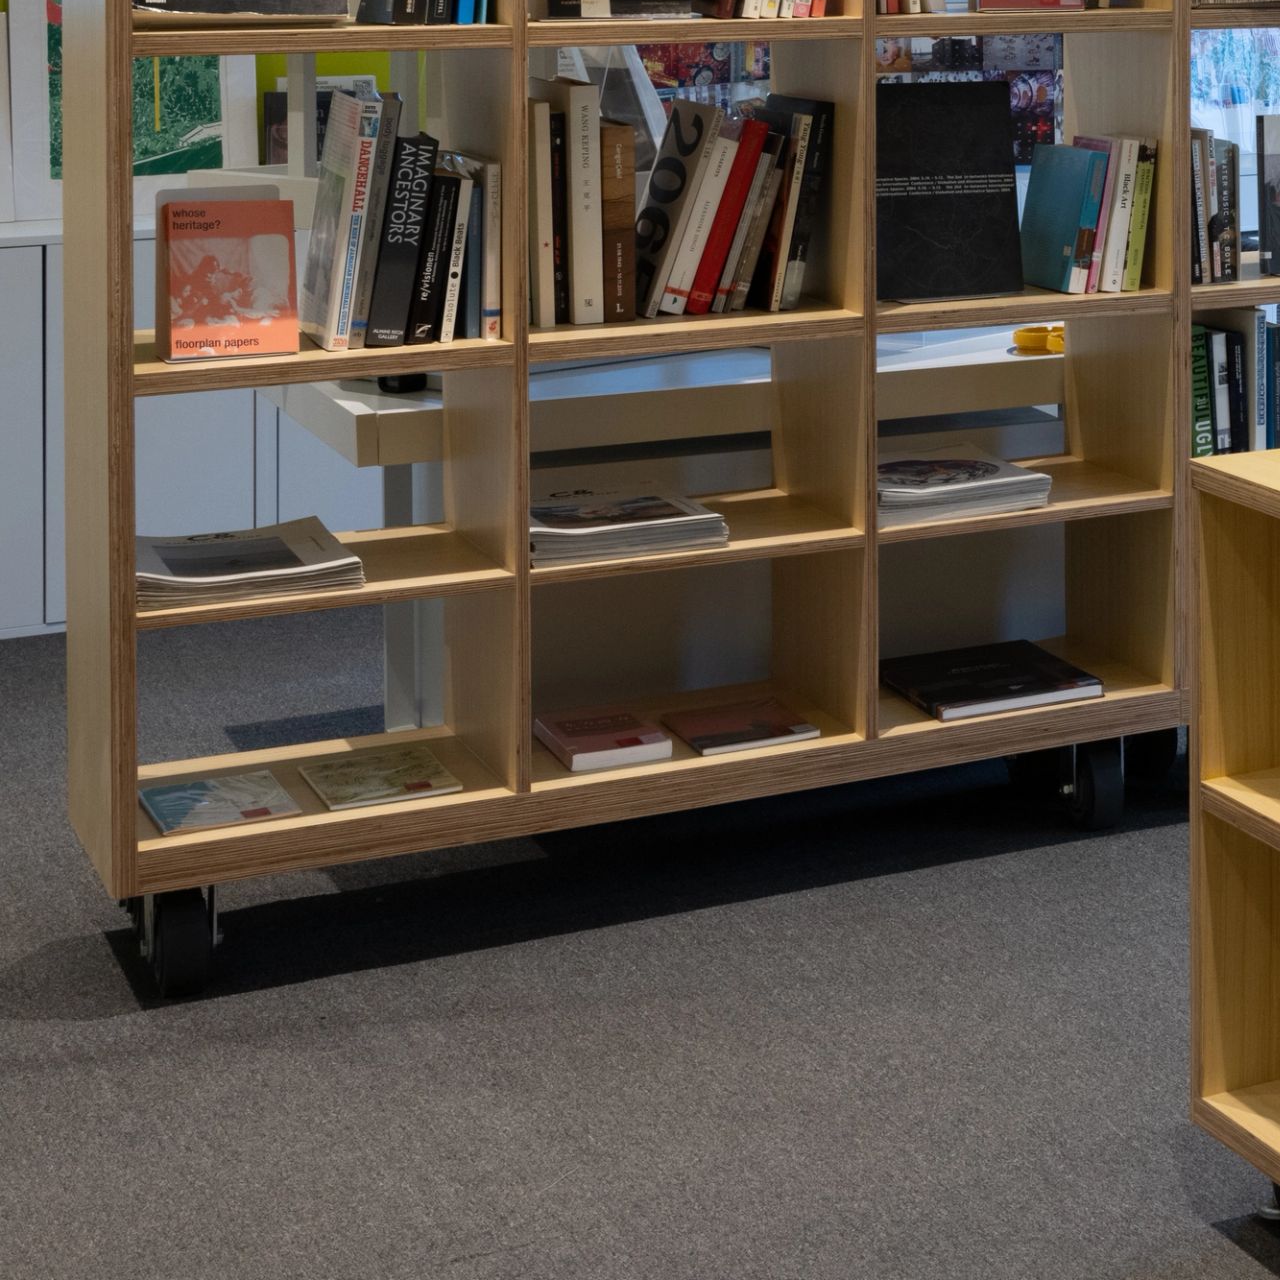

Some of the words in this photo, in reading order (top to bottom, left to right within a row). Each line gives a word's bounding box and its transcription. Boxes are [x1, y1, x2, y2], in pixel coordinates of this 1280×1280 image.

[581, 105, 591, 135] WANG
[800, 122, 811, 143] Yang
[581, 138, 591, 169] KEPING
[797, 144, 807, 165] Yong
[351, 140, 373, 212] DANCEHALL
[1121, 173, 1131, 194] Black
[387, 143, 417, 243] ANCESTORS
[404, 145, 433, 246] IMAGINARY
[1120, 196, 1128, 209] Art
[1221, 190, 1229, 216] MUSIC
[172, 208, 206, 220] whose
[172, 219, 221, 233] heritage?
[455, 223, 464, 242] Beats
[420, 251, 435, 301] re/visionen
[175, 338, 220, 350] floorplan
[223, 337, 260, 350] papers
[1192, 332, 1211, 421] BEAUTIFUL
